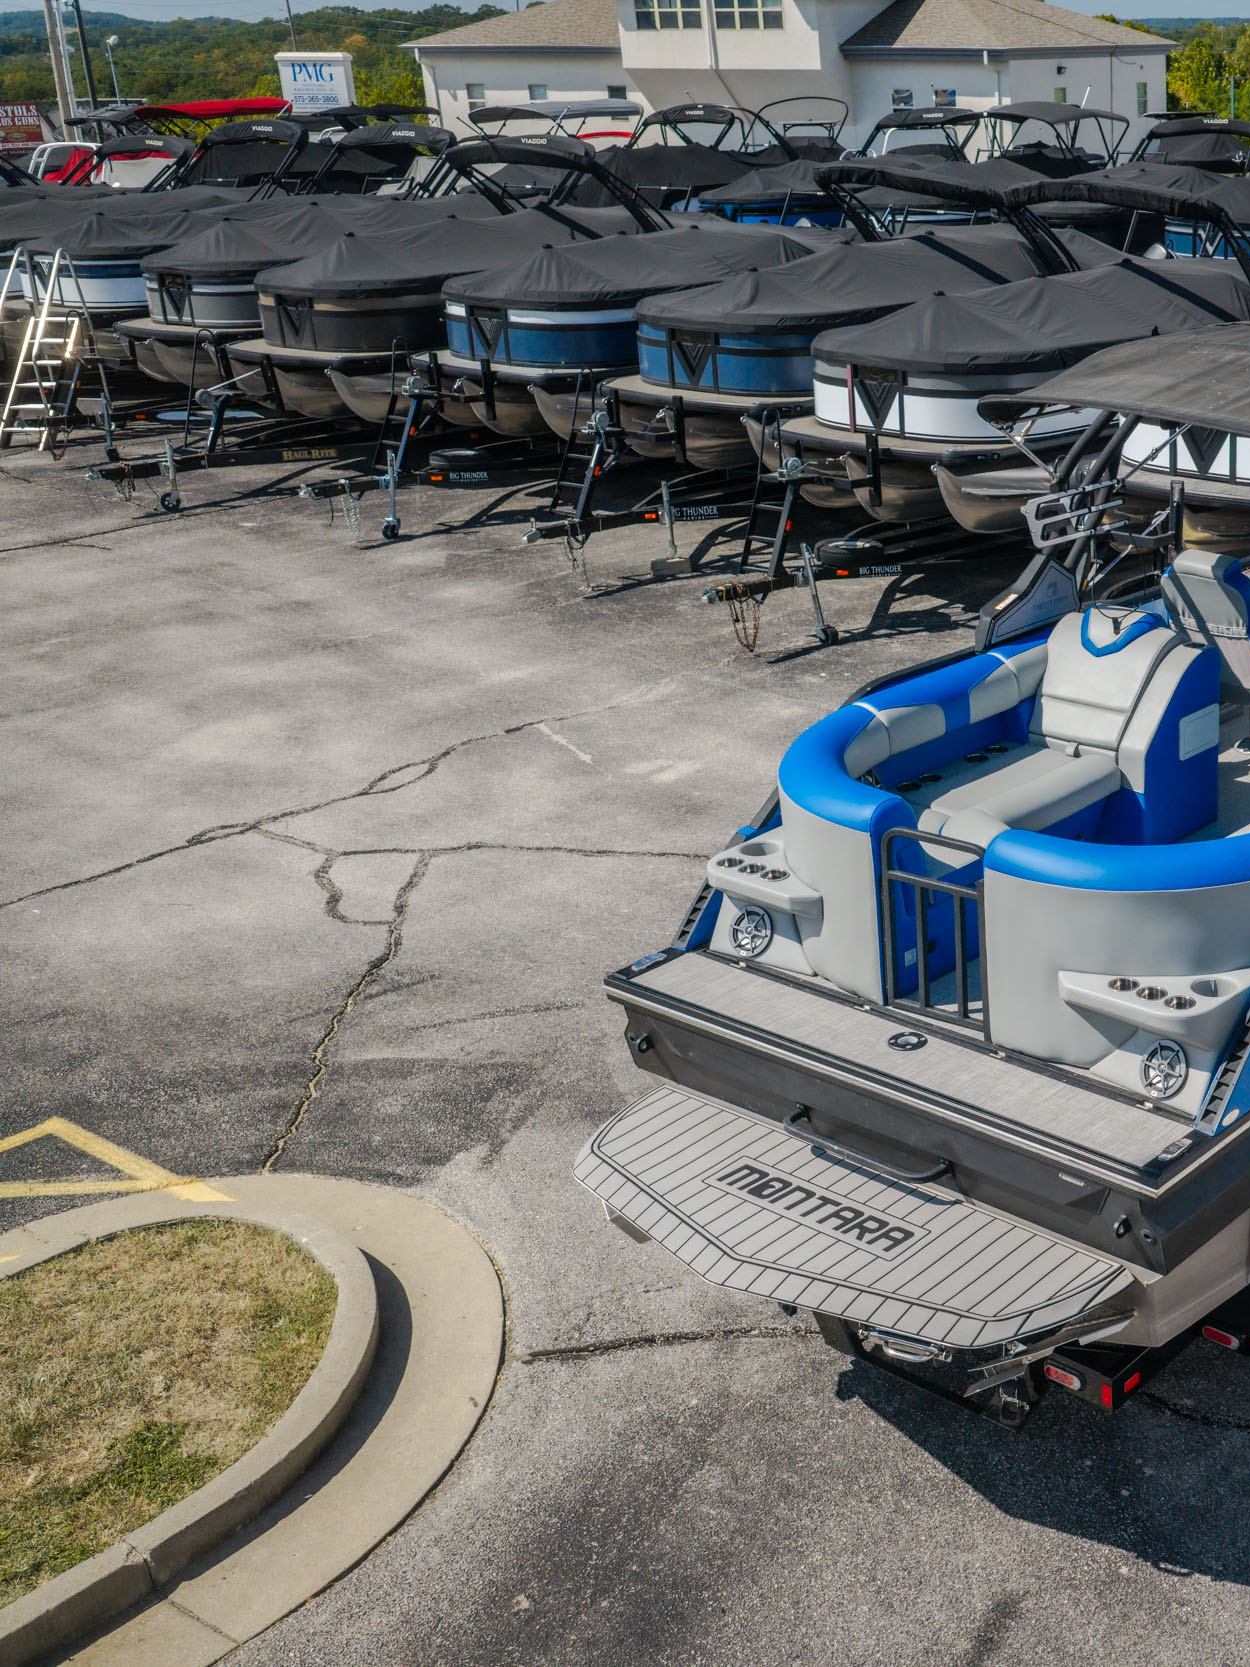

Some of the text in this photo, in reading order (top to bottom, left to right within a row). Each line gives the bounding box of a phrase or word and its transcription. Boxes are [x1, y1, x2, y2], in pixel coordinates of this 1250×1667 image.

[290, 62, 334, 82] PMG
[520, 137, 548, 145] VIAGGIO
[282, 449, 337, 460] HAUL RITE
[449, 471, 488, 480] BIG THUNDER
[682, 505, 719, 516] THUNDER
[859, 564, 902, 575] BIG THUNDER
[716, 1164, 915, 1252] MONTARA
